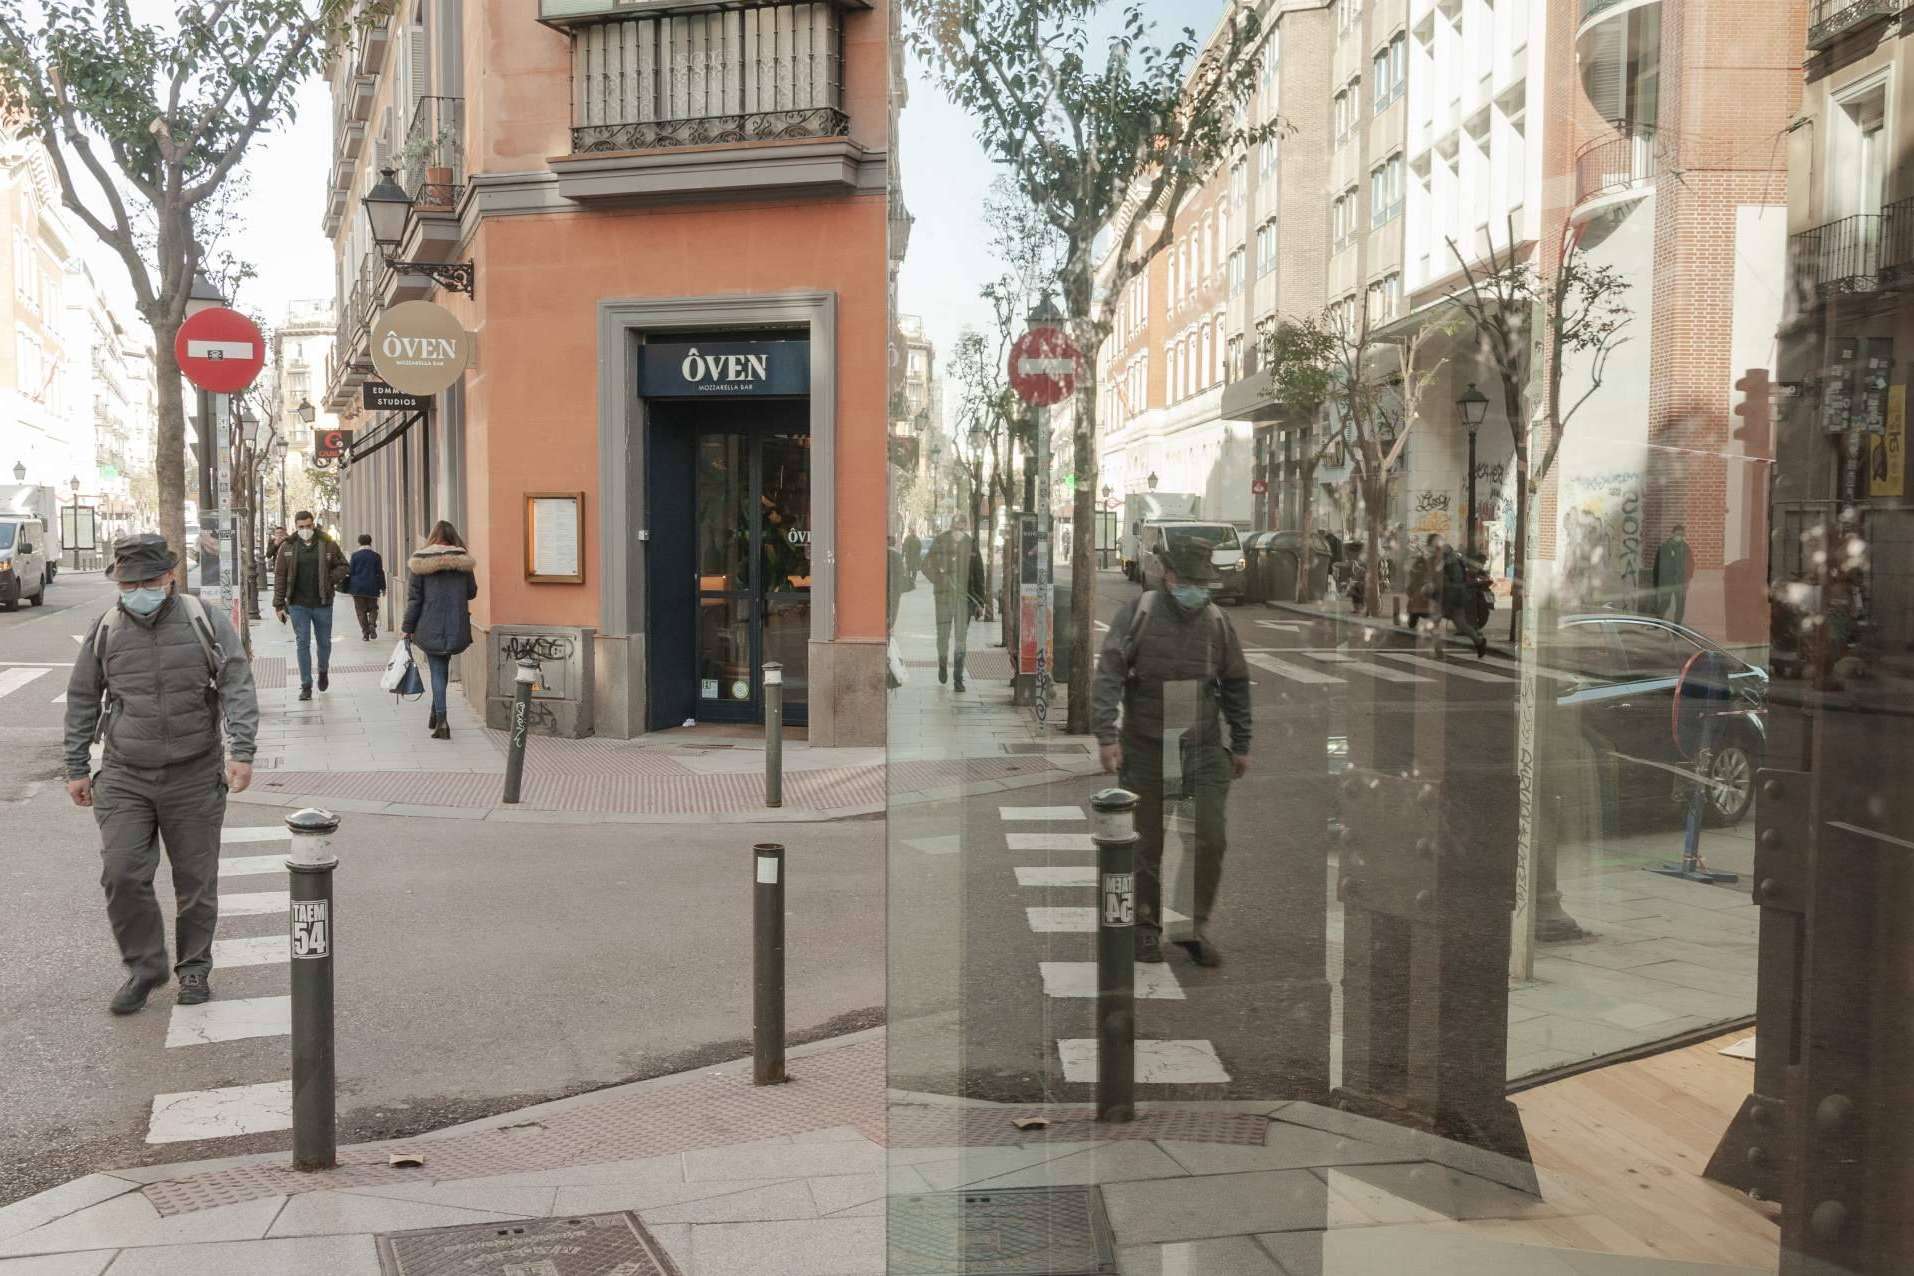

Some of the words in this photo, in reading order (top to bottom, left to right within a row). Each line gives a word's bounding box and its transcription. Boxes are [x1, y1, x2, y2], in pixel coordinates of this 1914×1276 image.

[383, 330, 456, 359] ÔVEN
[682, 347, 768, 382] ÔVEN
[377, 398, 416, 406] STUDIOS
[294, 921, 326, 955] 54
